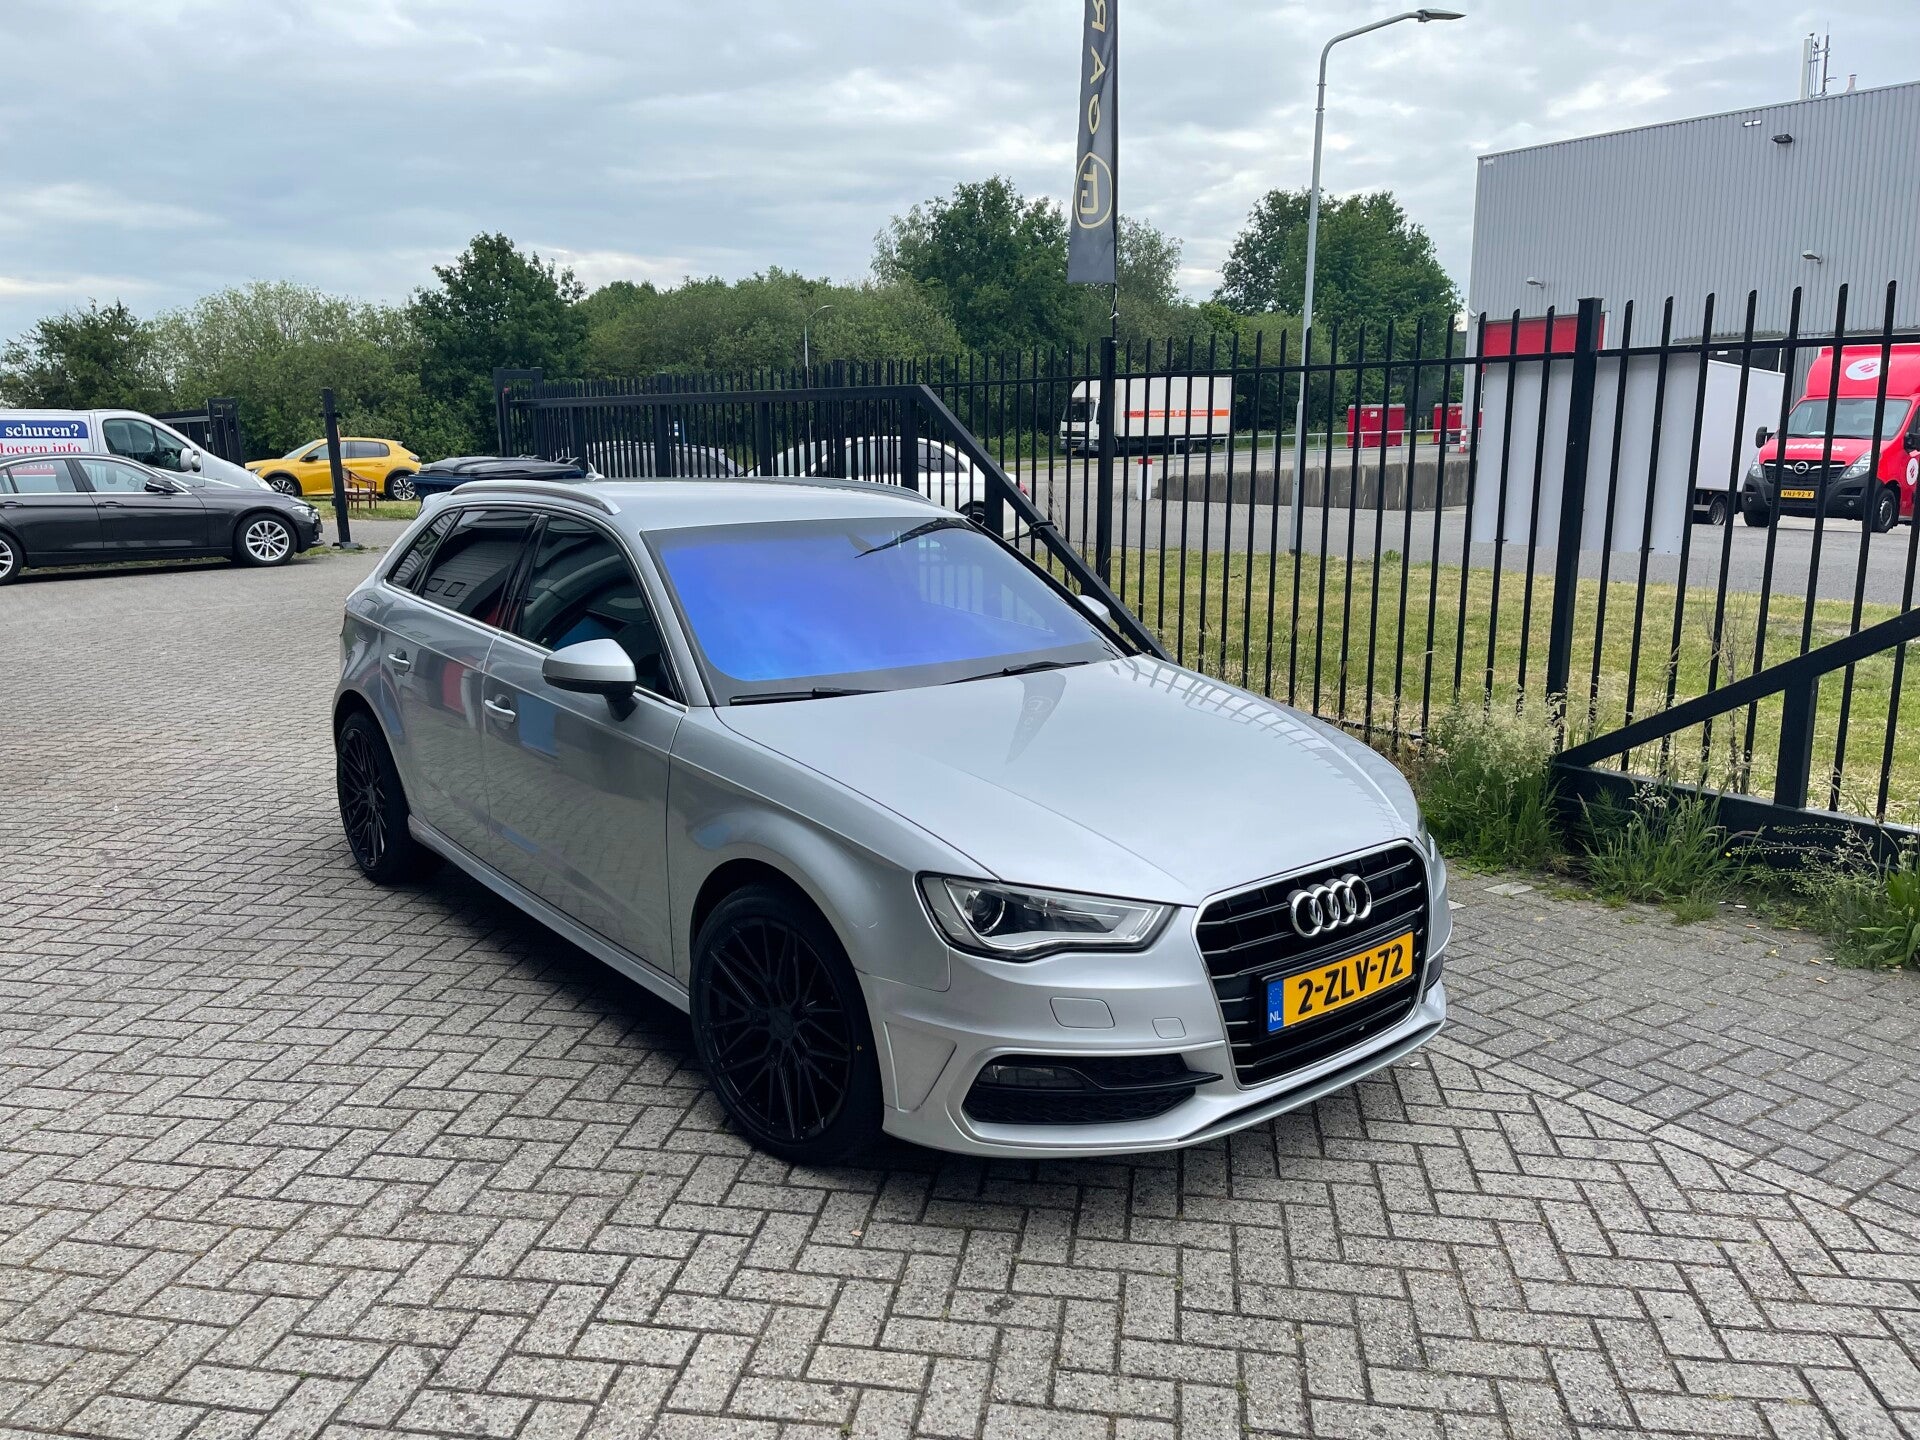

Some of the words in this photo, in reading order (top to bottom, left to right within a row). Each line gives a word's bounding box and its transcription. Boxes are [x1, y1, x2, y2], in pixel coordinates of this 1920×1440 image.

[5, 423, 79, 437] schuren?
[1297, 943, 1404, 1015] 2-ZLV-72
[1269, 1010, 1282, 1023] NL
